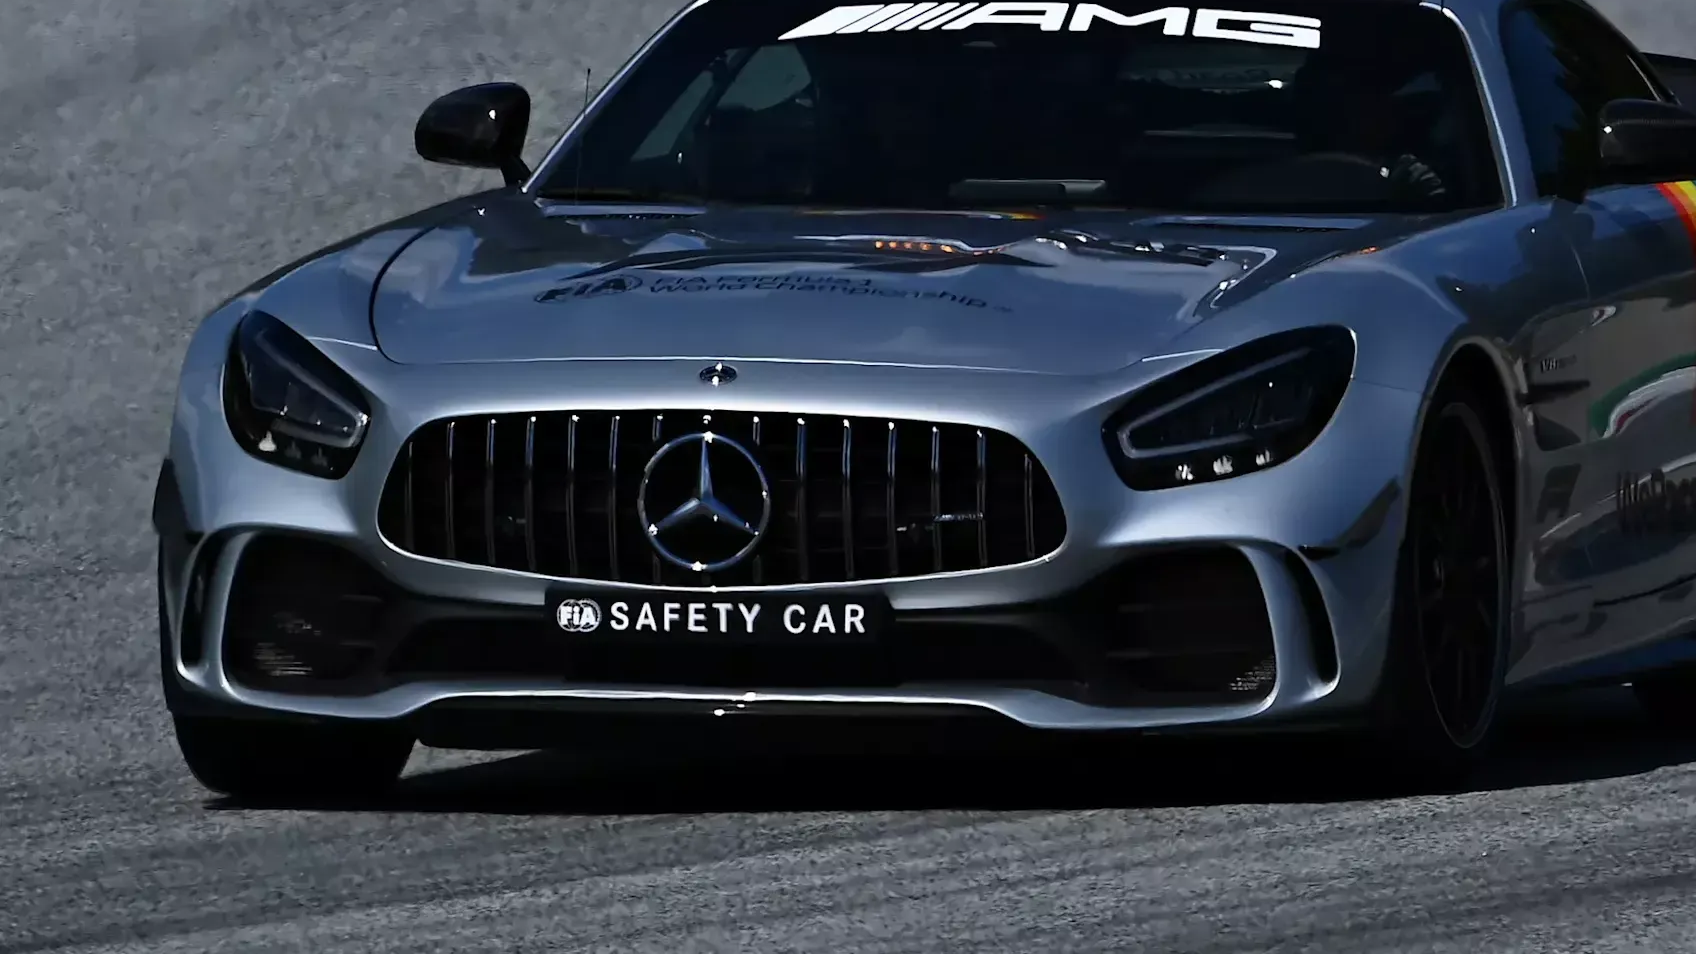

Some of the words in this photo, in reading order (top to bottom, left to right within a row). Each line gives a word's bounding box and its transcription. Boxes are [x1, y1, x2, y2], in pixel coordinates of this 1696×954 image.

[940, 2, 1321, 49] AMG
[609, 601, 761, 634] SAFETY
[782, 603, 866, 634] CAR
